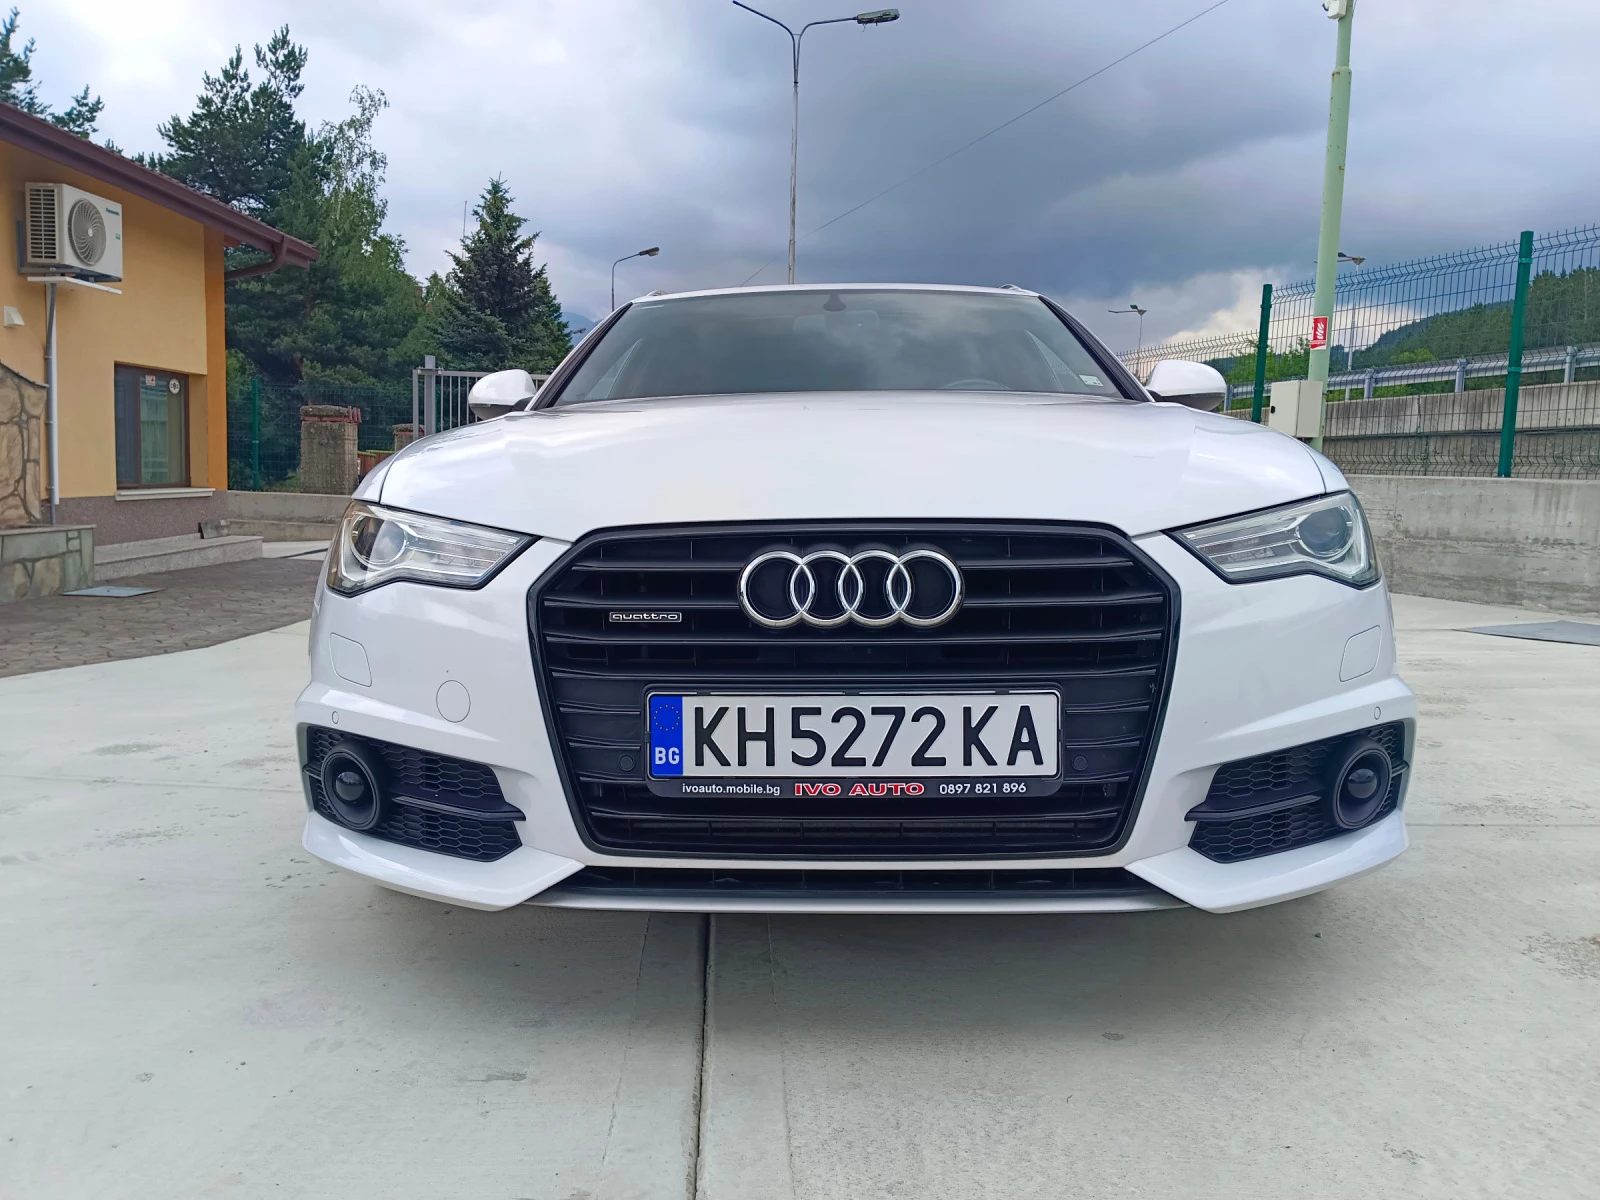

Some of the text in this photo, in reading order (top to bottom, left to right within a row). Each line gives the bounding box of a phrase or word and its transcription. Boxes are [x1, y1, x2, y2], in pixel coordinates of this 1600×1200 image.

[612, 613, 678, 621] quattro
[694, 705, 1043, 767] KH 5272 KA
[655, 747, 680, 765] BG
[682, 783, 780, 796] ivoauto.mobile.bg
[794, 783, 925, 796] IVO AUTO
[939, 782, 1027, 795] 0897 821 896
